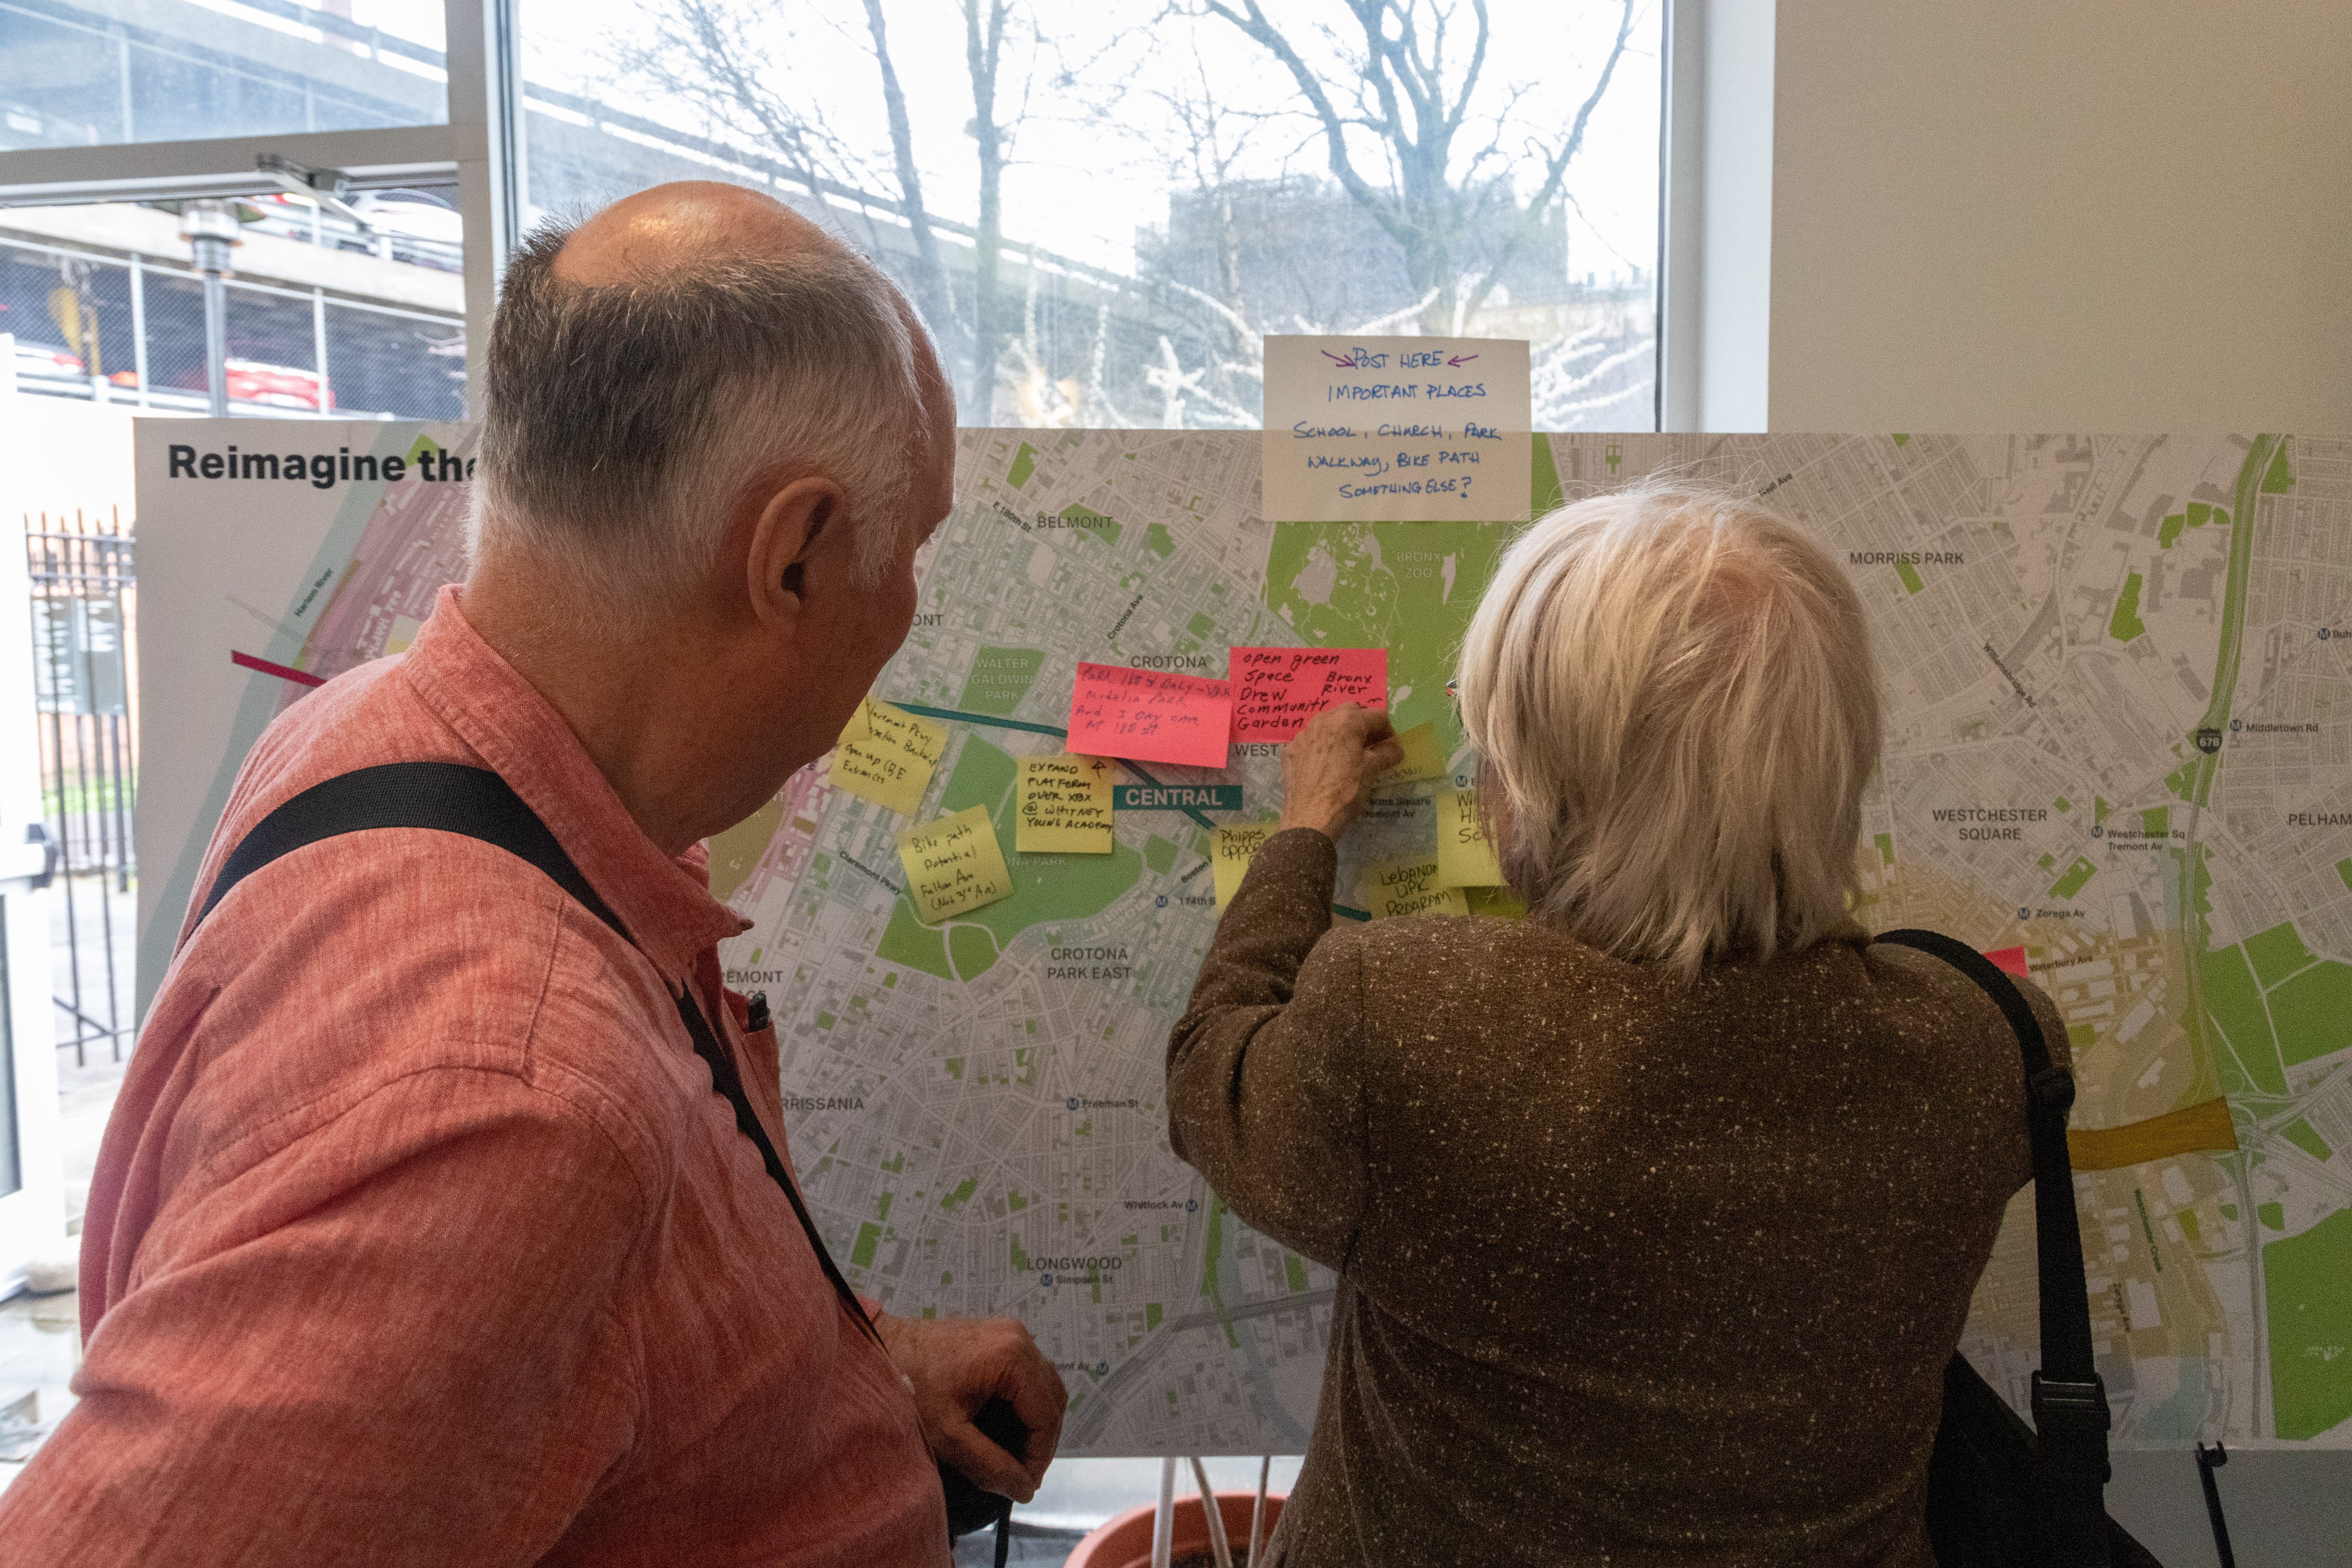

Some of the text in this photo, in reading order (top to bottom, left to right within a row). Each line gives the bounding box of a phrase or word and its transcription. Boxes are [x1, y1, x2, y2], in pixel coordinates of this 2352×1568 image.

[1353, 347, 1444, 369] POST HERE
[1329, 383, 1486, 402] IMPORTANT PLACES
[1464, 422, 1502, 441] PARK
[1397, 452, 1430, 468] BIKE
[1439, 452, 1480, 465] PATH
[168, 445, 406, 489] Reimagine
[1339, 479, 1423, 499] SOMETHING
[1037, 516, 1114, 529] BELMONT
[1396, 552, 1441, 563] BRONX
[1850, 552, 1965, 565] MORRISS PARK
[1405, 567, 1433, 579] ZOO
[1107, 594, 1144, 640] Crotona Ave
[976, 658, 1029, 669] WALTER
[1131, 655, 1207, 668] CROTONA
[1290, 654, 1340, 672] green
[1244, 669, 1372, 686] Space Bronx
[985, 690, 1019, 700] PARK
[1239, 683, 1367, 703] Drew River
[1237, 716, 1305, 730] Garden
[2246, 723, 2303, 733] Middletown
[2305, 723, 2319, 732] Rd
[2200, 737, 2220, 747] 678
[1235, 744, 1277, 756] WEST
[1027, 791, 1064, 802] OVER
[1125, 788, 1223, 806] CENTRAL
[1022, 801, 1038, 816] @
[1932, 809, 2047, 822] WESTCHESTER
[2288, 813, 2352, 825] PELHAM
[1959, 828, 2022, 841] SQUARE
[2172, 830, 2185, 839] Sq
[911, 835, 938, 854] Bike
[2108, 842, 2163, 851] Tremont Av
[839, 851, 880, 881] Claremont
[2036, 909, 2070, 919] Zerega
[2072, 908, 2085, 917] Av
[1051, 947, 1128, 961] CROTONA
[2077, 954, 2093, 965] Ave
[724, 970, 783, 983] EMONT
[1047, 966, 1132, 980] PARK EAST
[782, 1097, 864, 1110] RRISSANIA
[1127, 1099, 1139, 1108] St
[1171, 1200, 1184, 1209] Av
[1027, 1257, 1122, 1271] LONGWOOD
[1102, 1274, 1113, 1283] St
